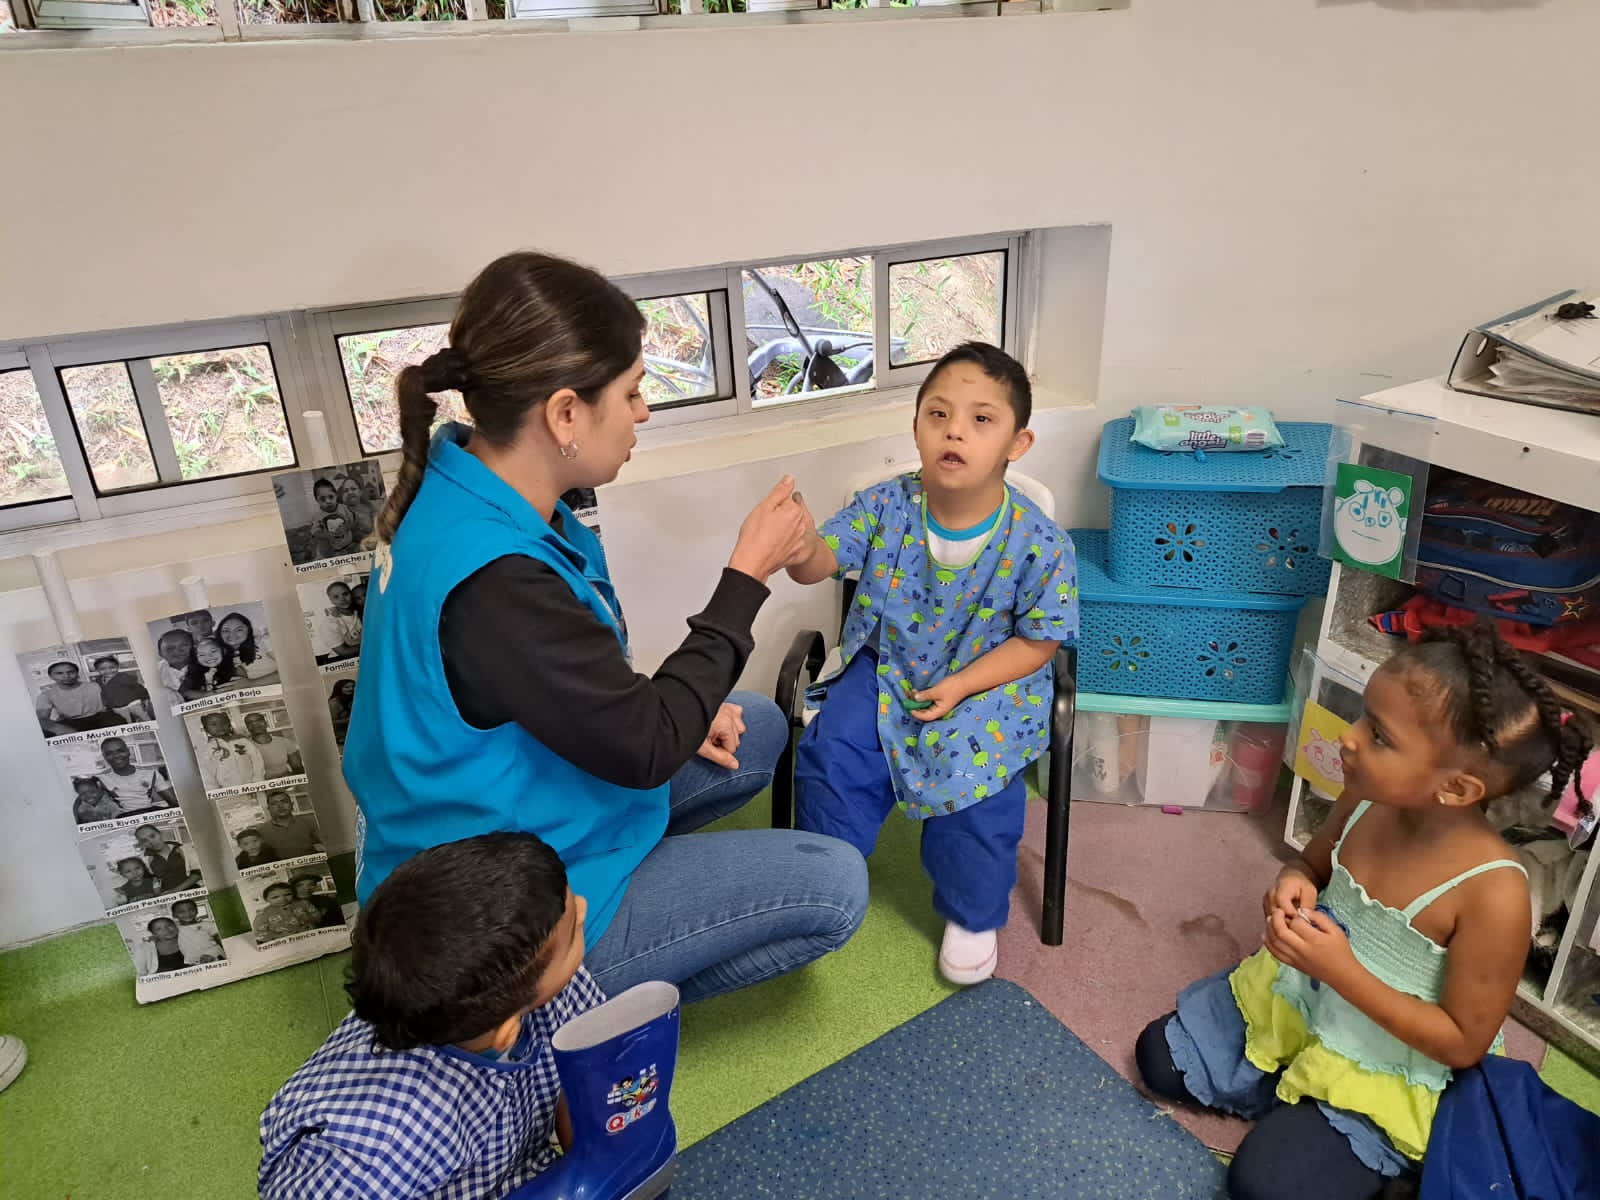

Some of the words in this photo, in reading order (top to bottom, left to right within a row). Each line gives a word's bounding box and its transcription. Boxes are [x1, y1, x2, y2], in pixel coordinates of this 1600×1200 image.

[1189, 430, 1217, 442] little
[296, 561, 328, 574] Familia
[330, 555, 366, 567] Sánchez
[325, 660, 355, 672] Familia
[180, 699, 213, 712] Familia
[215, 693, 237, 703] León
[239, 688, 262, 698] Borja
[47, 734, 84, 747] Familia
[207, 789, 240, 799] Familia
[241, 784, 266, 793] Moya
[79, 822, 114, 832] Familia
[240, 866, 271, 877] Familia
[106, 904, 139, 917] Familia
[257, 939, 287, 951] Familia
[139, 973, 172, 984] Familia
